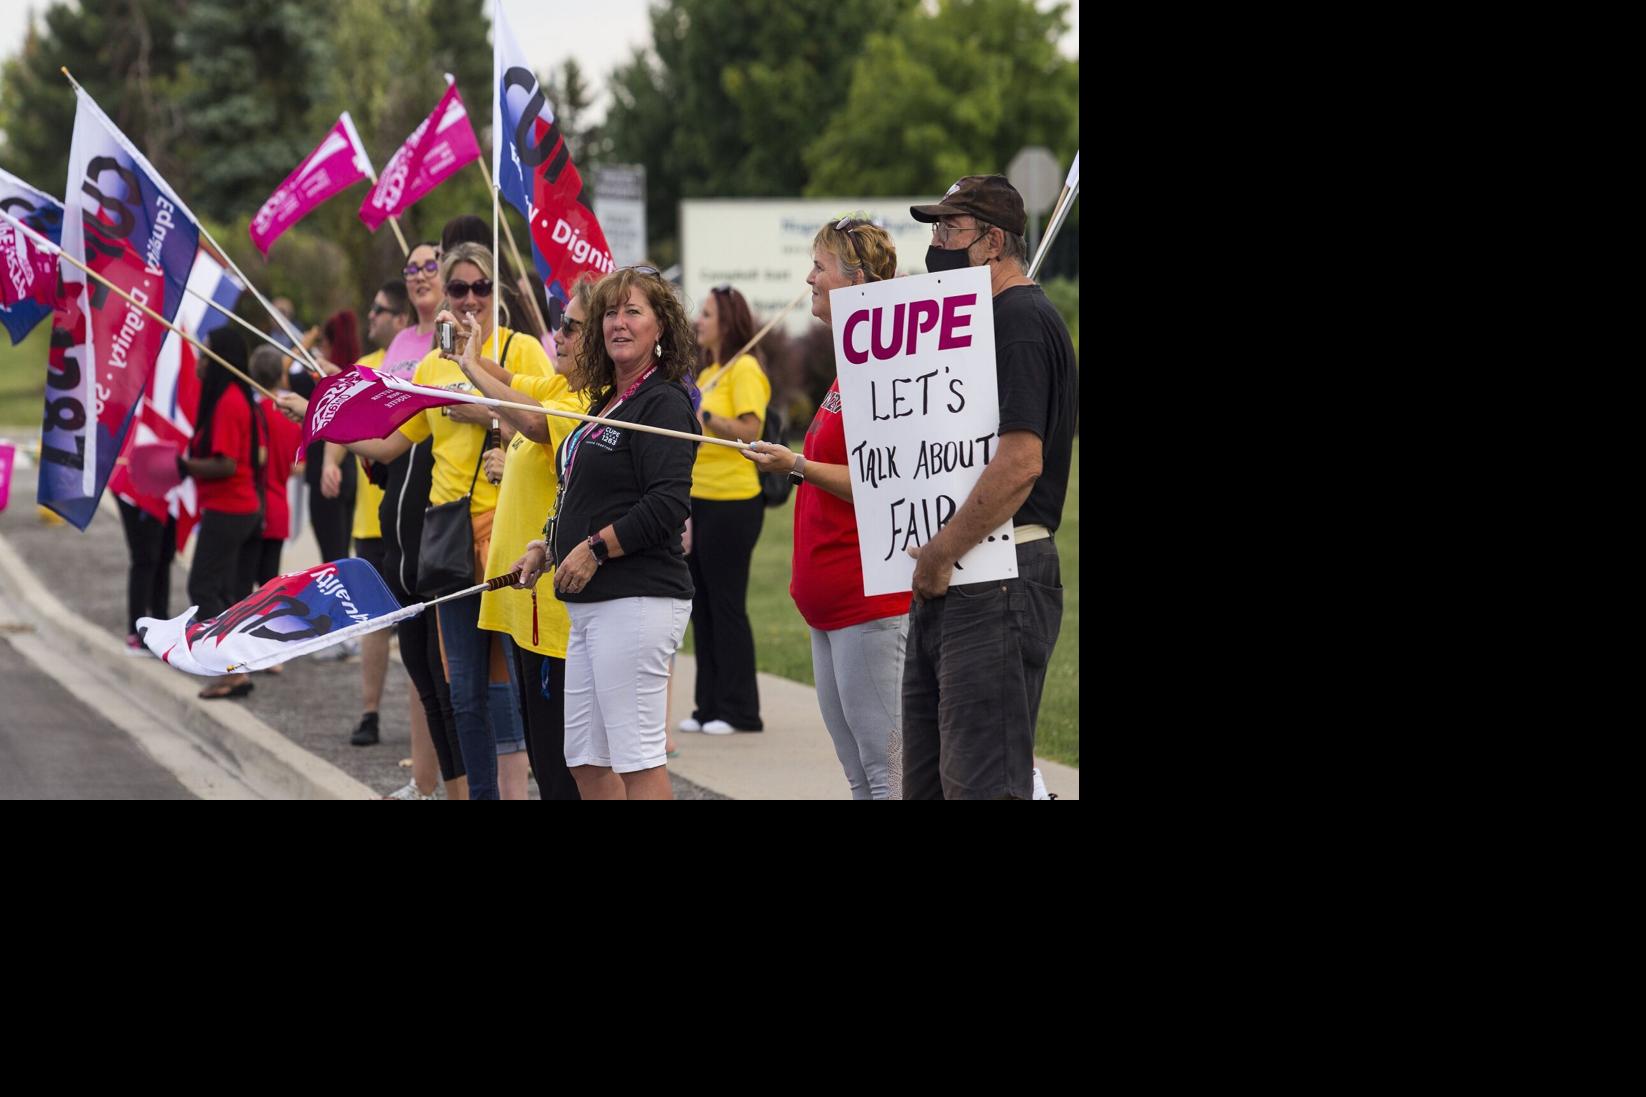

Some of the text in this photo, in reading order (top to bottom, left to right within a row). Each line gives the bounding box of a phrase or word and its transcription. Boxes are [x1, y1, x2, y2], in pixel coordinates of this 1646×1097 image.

[551, 218, 617, 274] Dignit
[843, 293, 977, 365] CUPE
[871, 366, 965, 421] LET'S
[605, 426, 621, 438] CUPE
[852, 432, 995, 489] TALK ABOUT
[310, 566, 370, 624] quality
